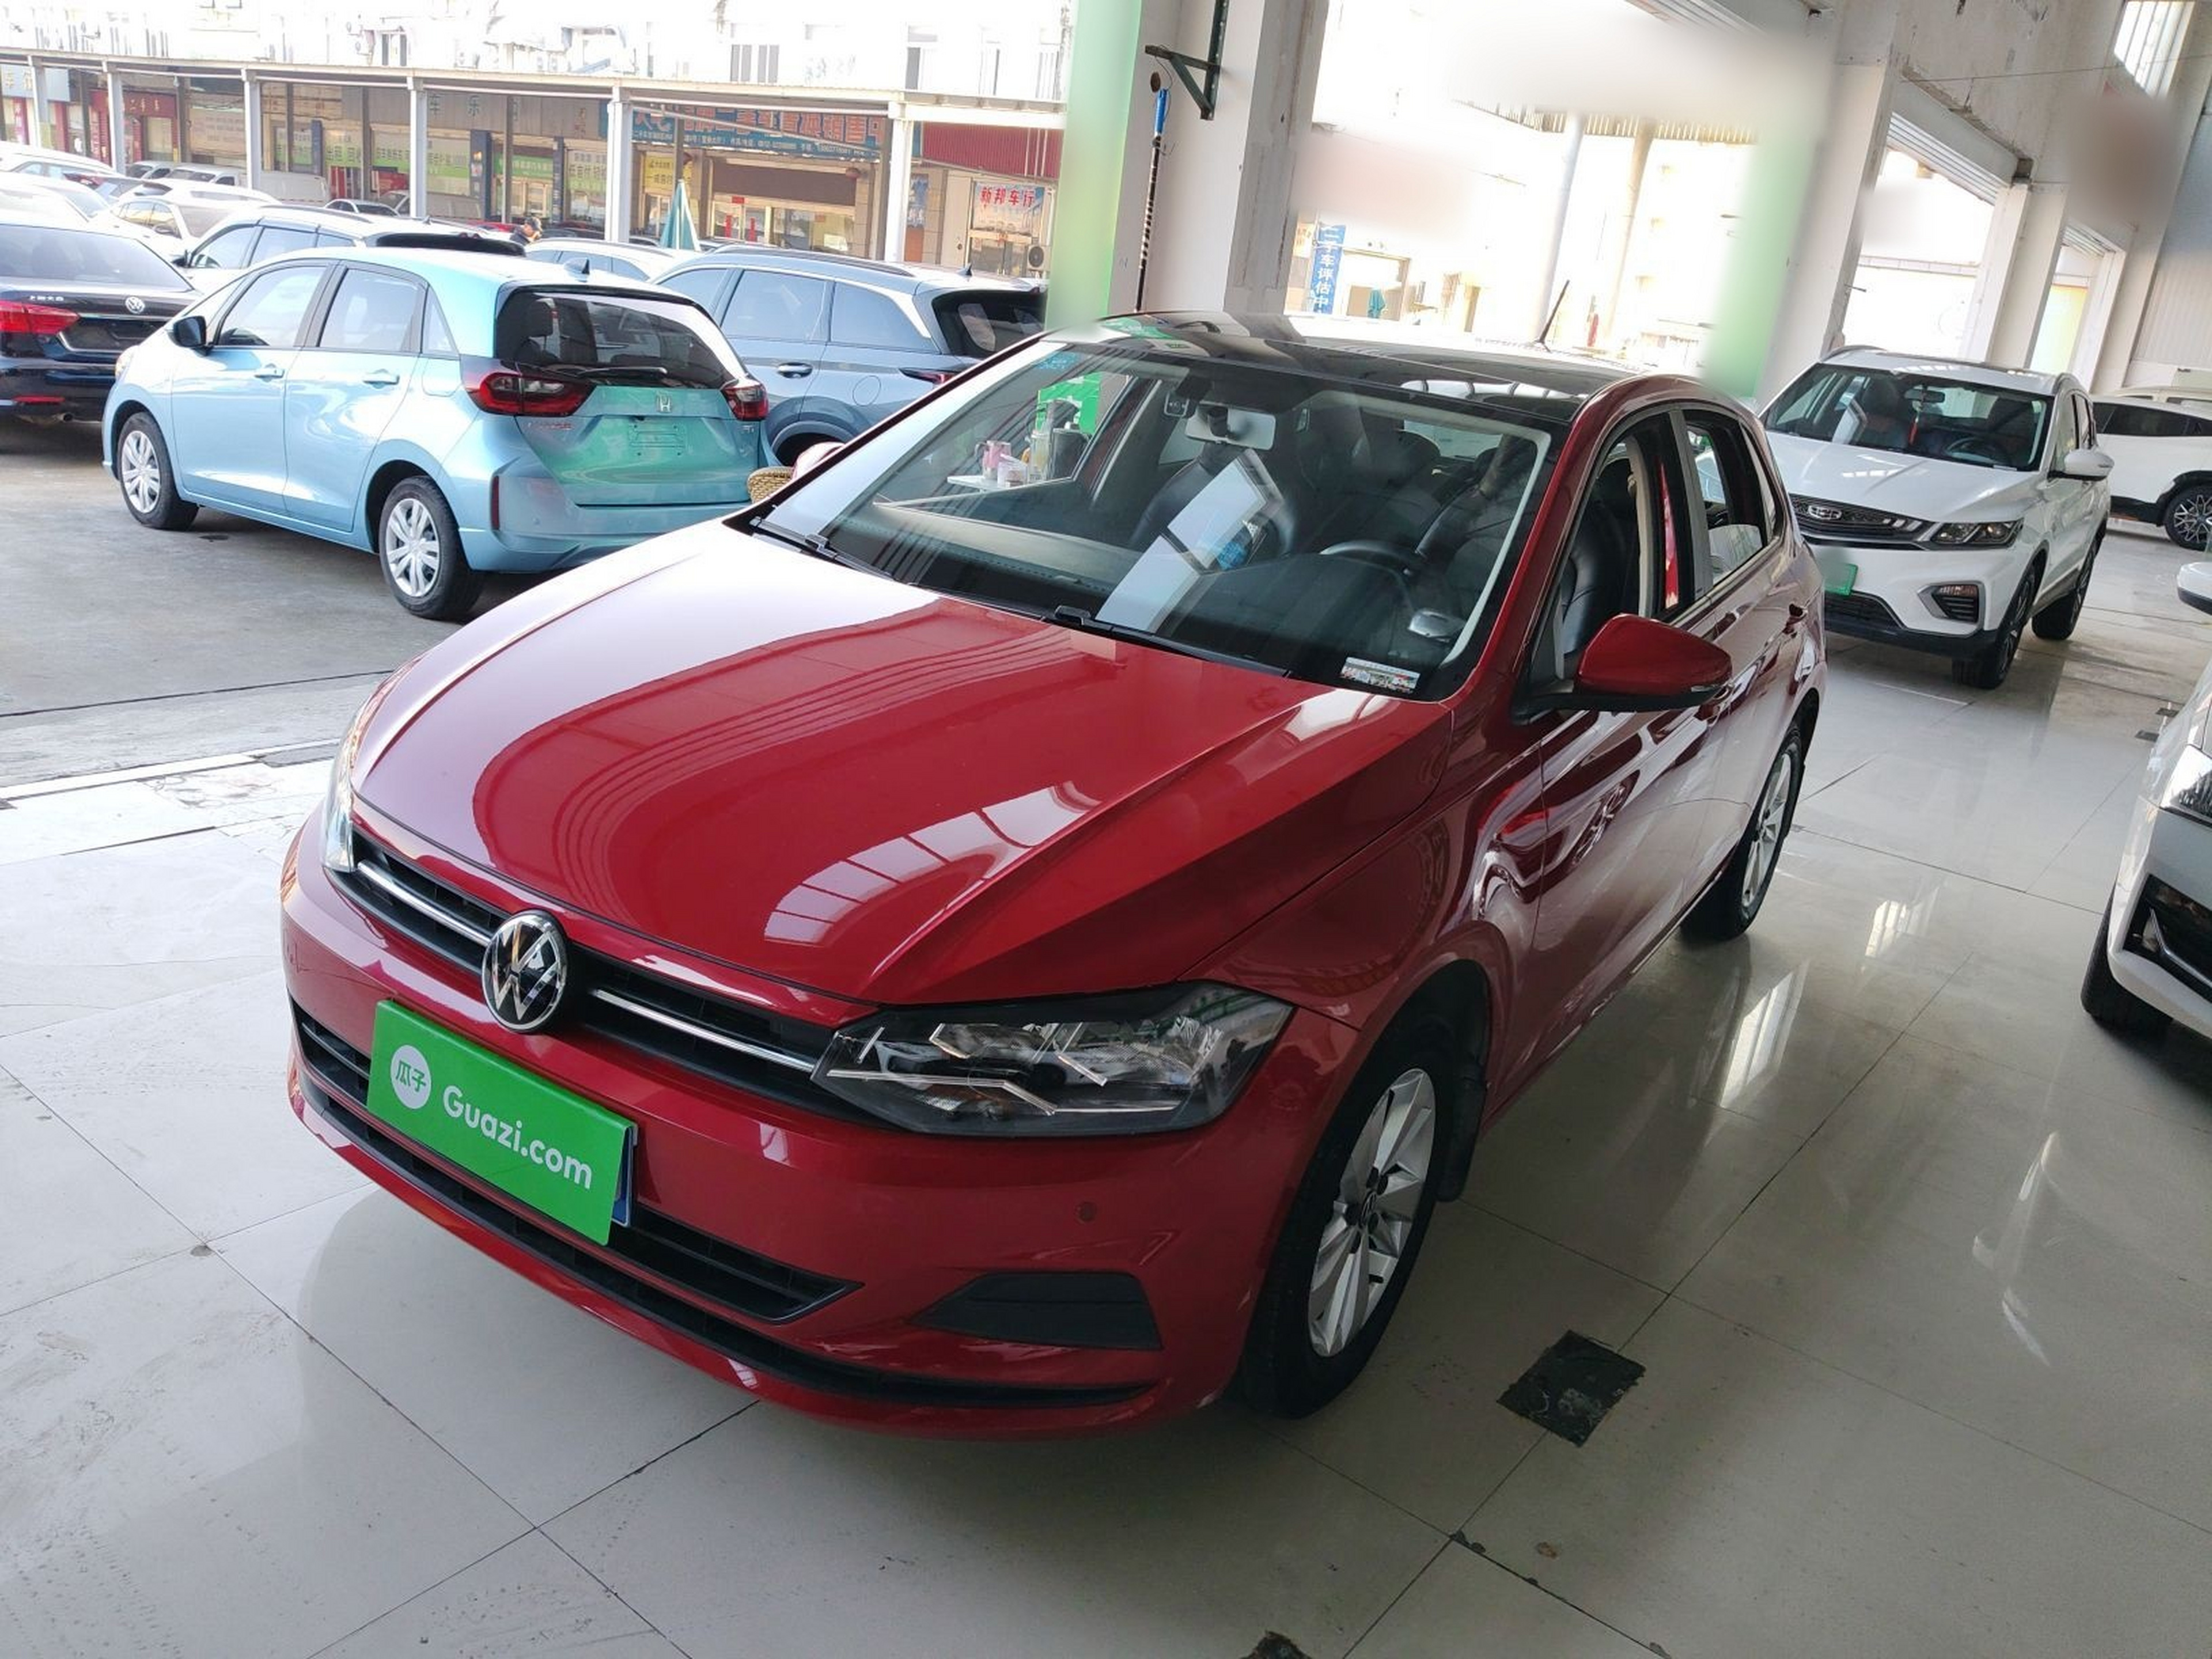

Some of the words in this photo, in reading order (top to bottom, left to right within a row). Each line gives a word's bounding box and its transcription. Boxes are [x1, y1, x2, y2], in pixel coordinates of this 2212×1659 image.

[1313, 226, 1340, 312] 二手车评估中
[396, 1060, 426, 1092] 瓜子
[442, 1085, 593, 1191] Guazi.com
